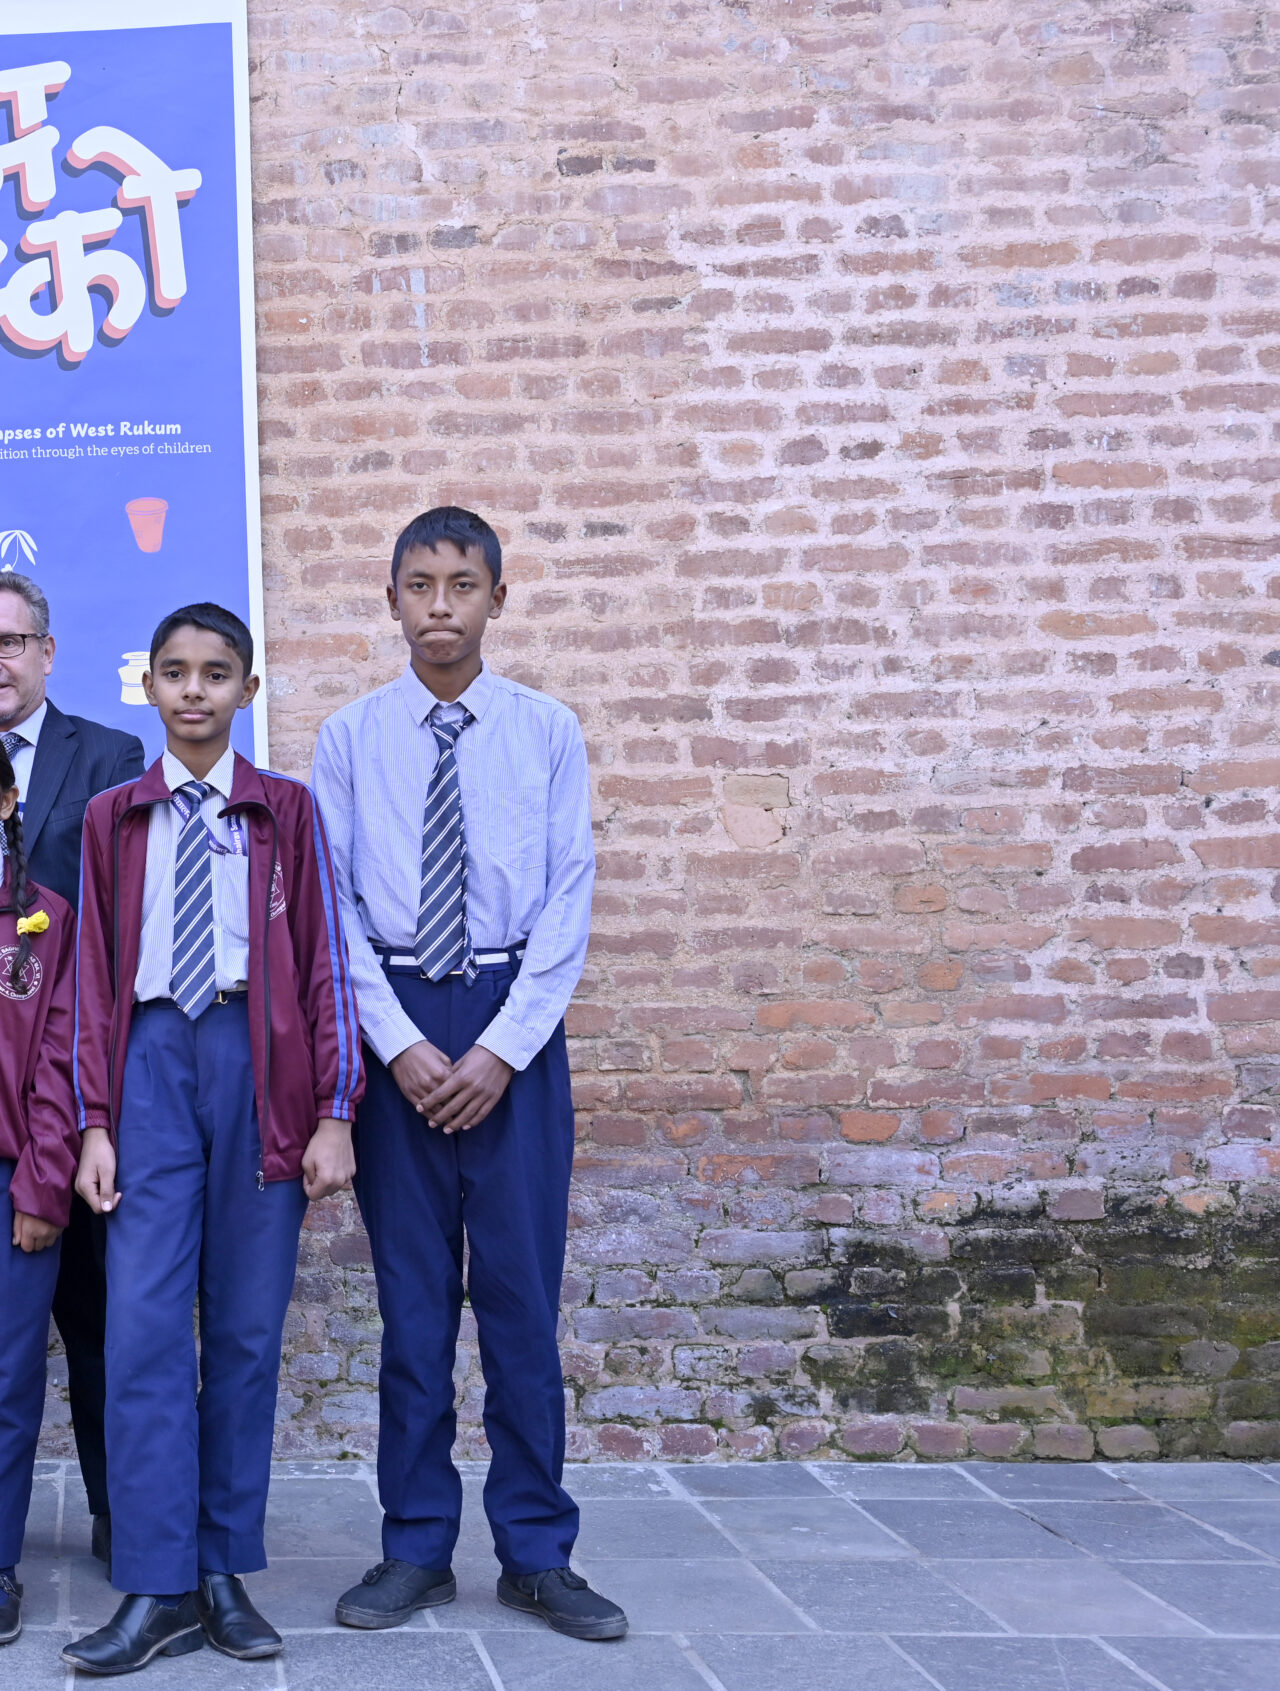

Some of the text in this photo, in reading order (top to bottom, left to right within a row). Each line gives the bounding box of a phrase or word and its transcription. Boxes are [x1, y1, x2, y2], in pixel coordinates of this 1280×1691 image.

[46, 423, 66, 438] of
[70, 423, 115, 438] West
[120, 420, 181, 436] Rukum
[32, 445, 84, 459] through
[87, 445, 108, 456] the
[111, 446, 140, 458] eyes
[142, 443, 155, 455] of
[157, 442, 212, 455] children
